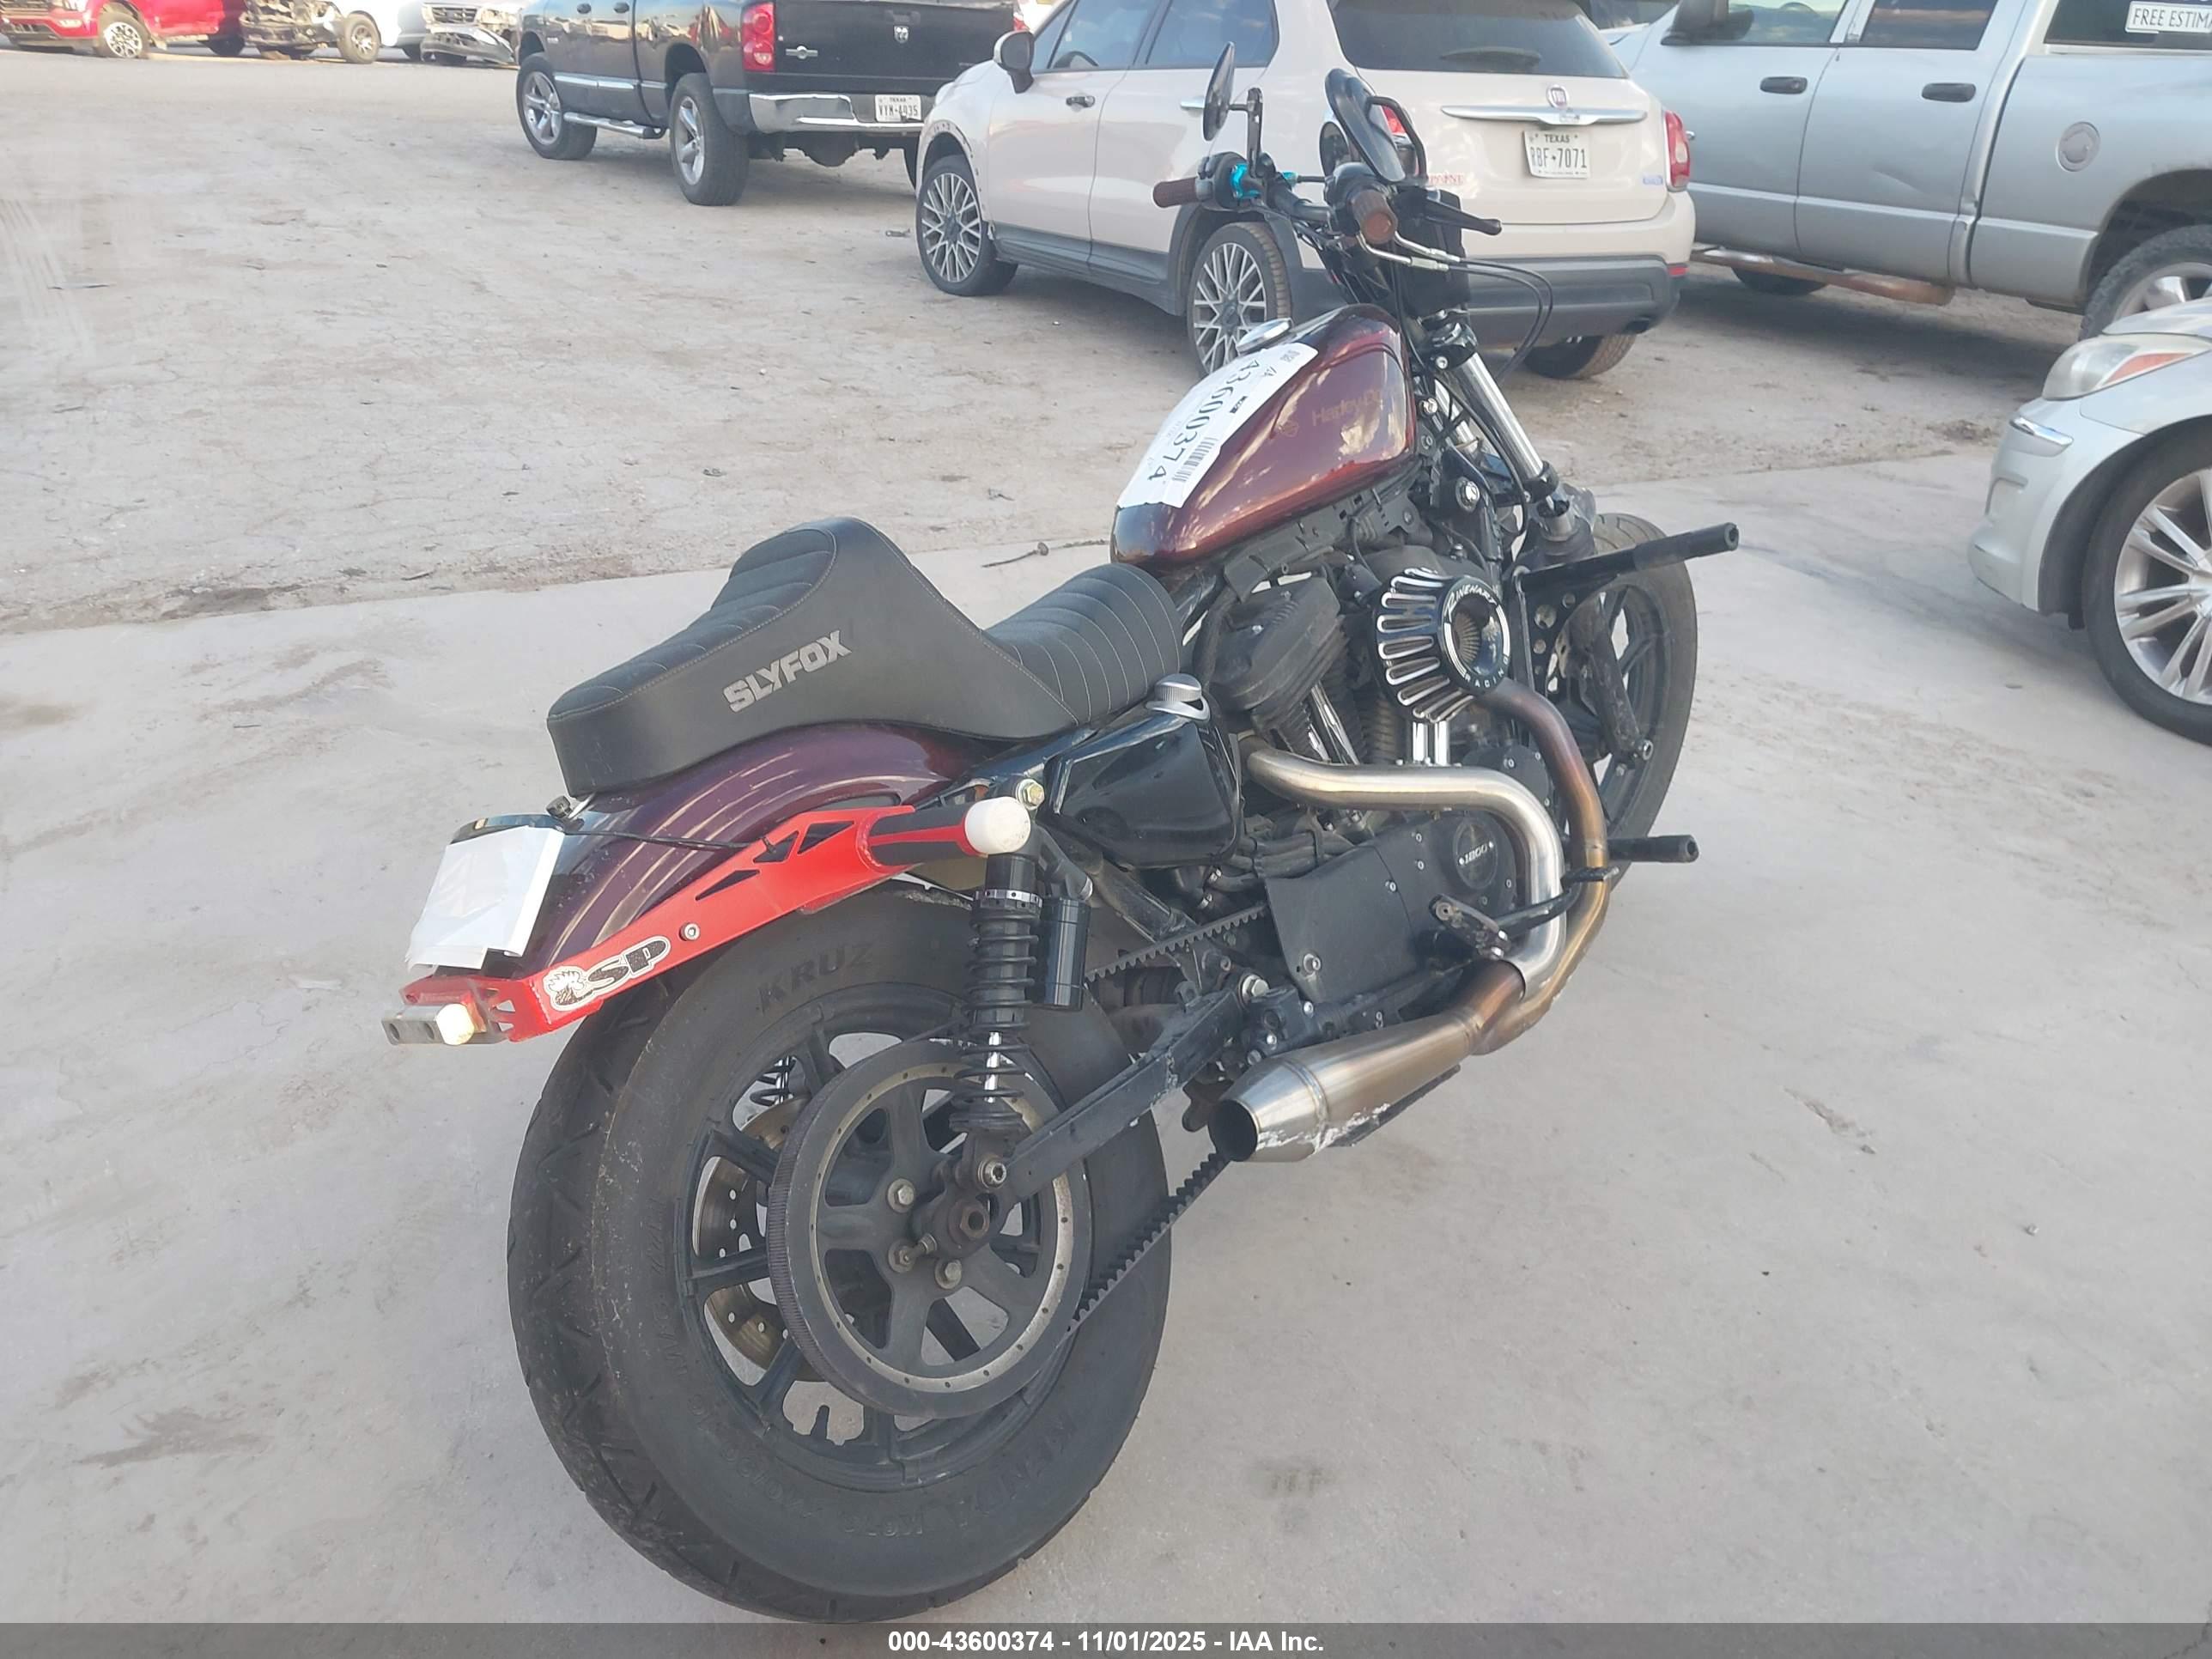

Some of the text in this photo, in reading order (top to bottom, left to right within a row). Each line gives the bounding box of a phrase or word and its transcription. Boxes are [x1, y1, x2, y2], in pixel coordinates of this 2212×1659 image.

[2132, 8, 2166, 27] FREE
[1544, 133, 1571, 143] TEXAS
[1147, 359, 1260, 481] 43600374
[1443, 584, 1498, 623] RINEHART
[723, 629, 853, 713] SLYFOX
[1465, 657, 1510, 688] RACING
[757, 943, 876, 1016] KRUZ
